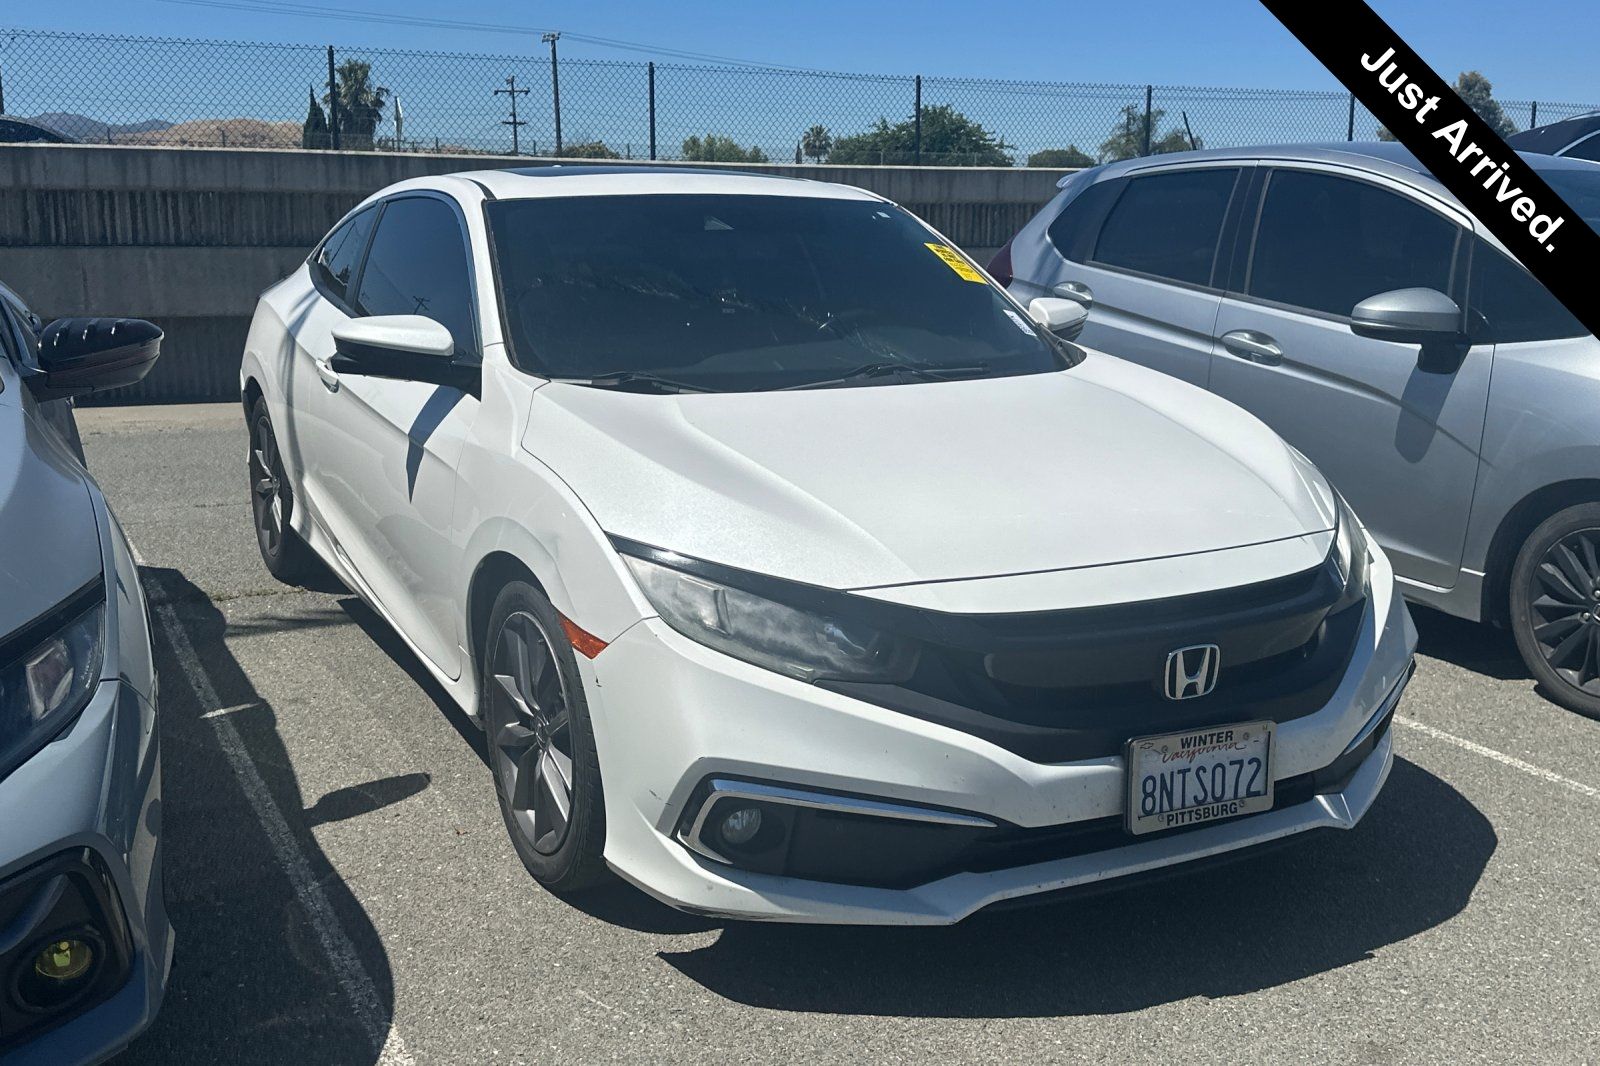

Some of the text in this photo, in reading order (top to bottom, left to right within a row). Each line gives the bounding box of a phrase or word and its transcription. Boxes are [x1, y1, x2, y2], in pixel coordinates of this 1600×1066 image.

[1180, 730, 1234, 749] WINTER
[1141, 757, 1261, 815] 8NTS072
[1166, 802, 1238, 826] PITTSBURG
